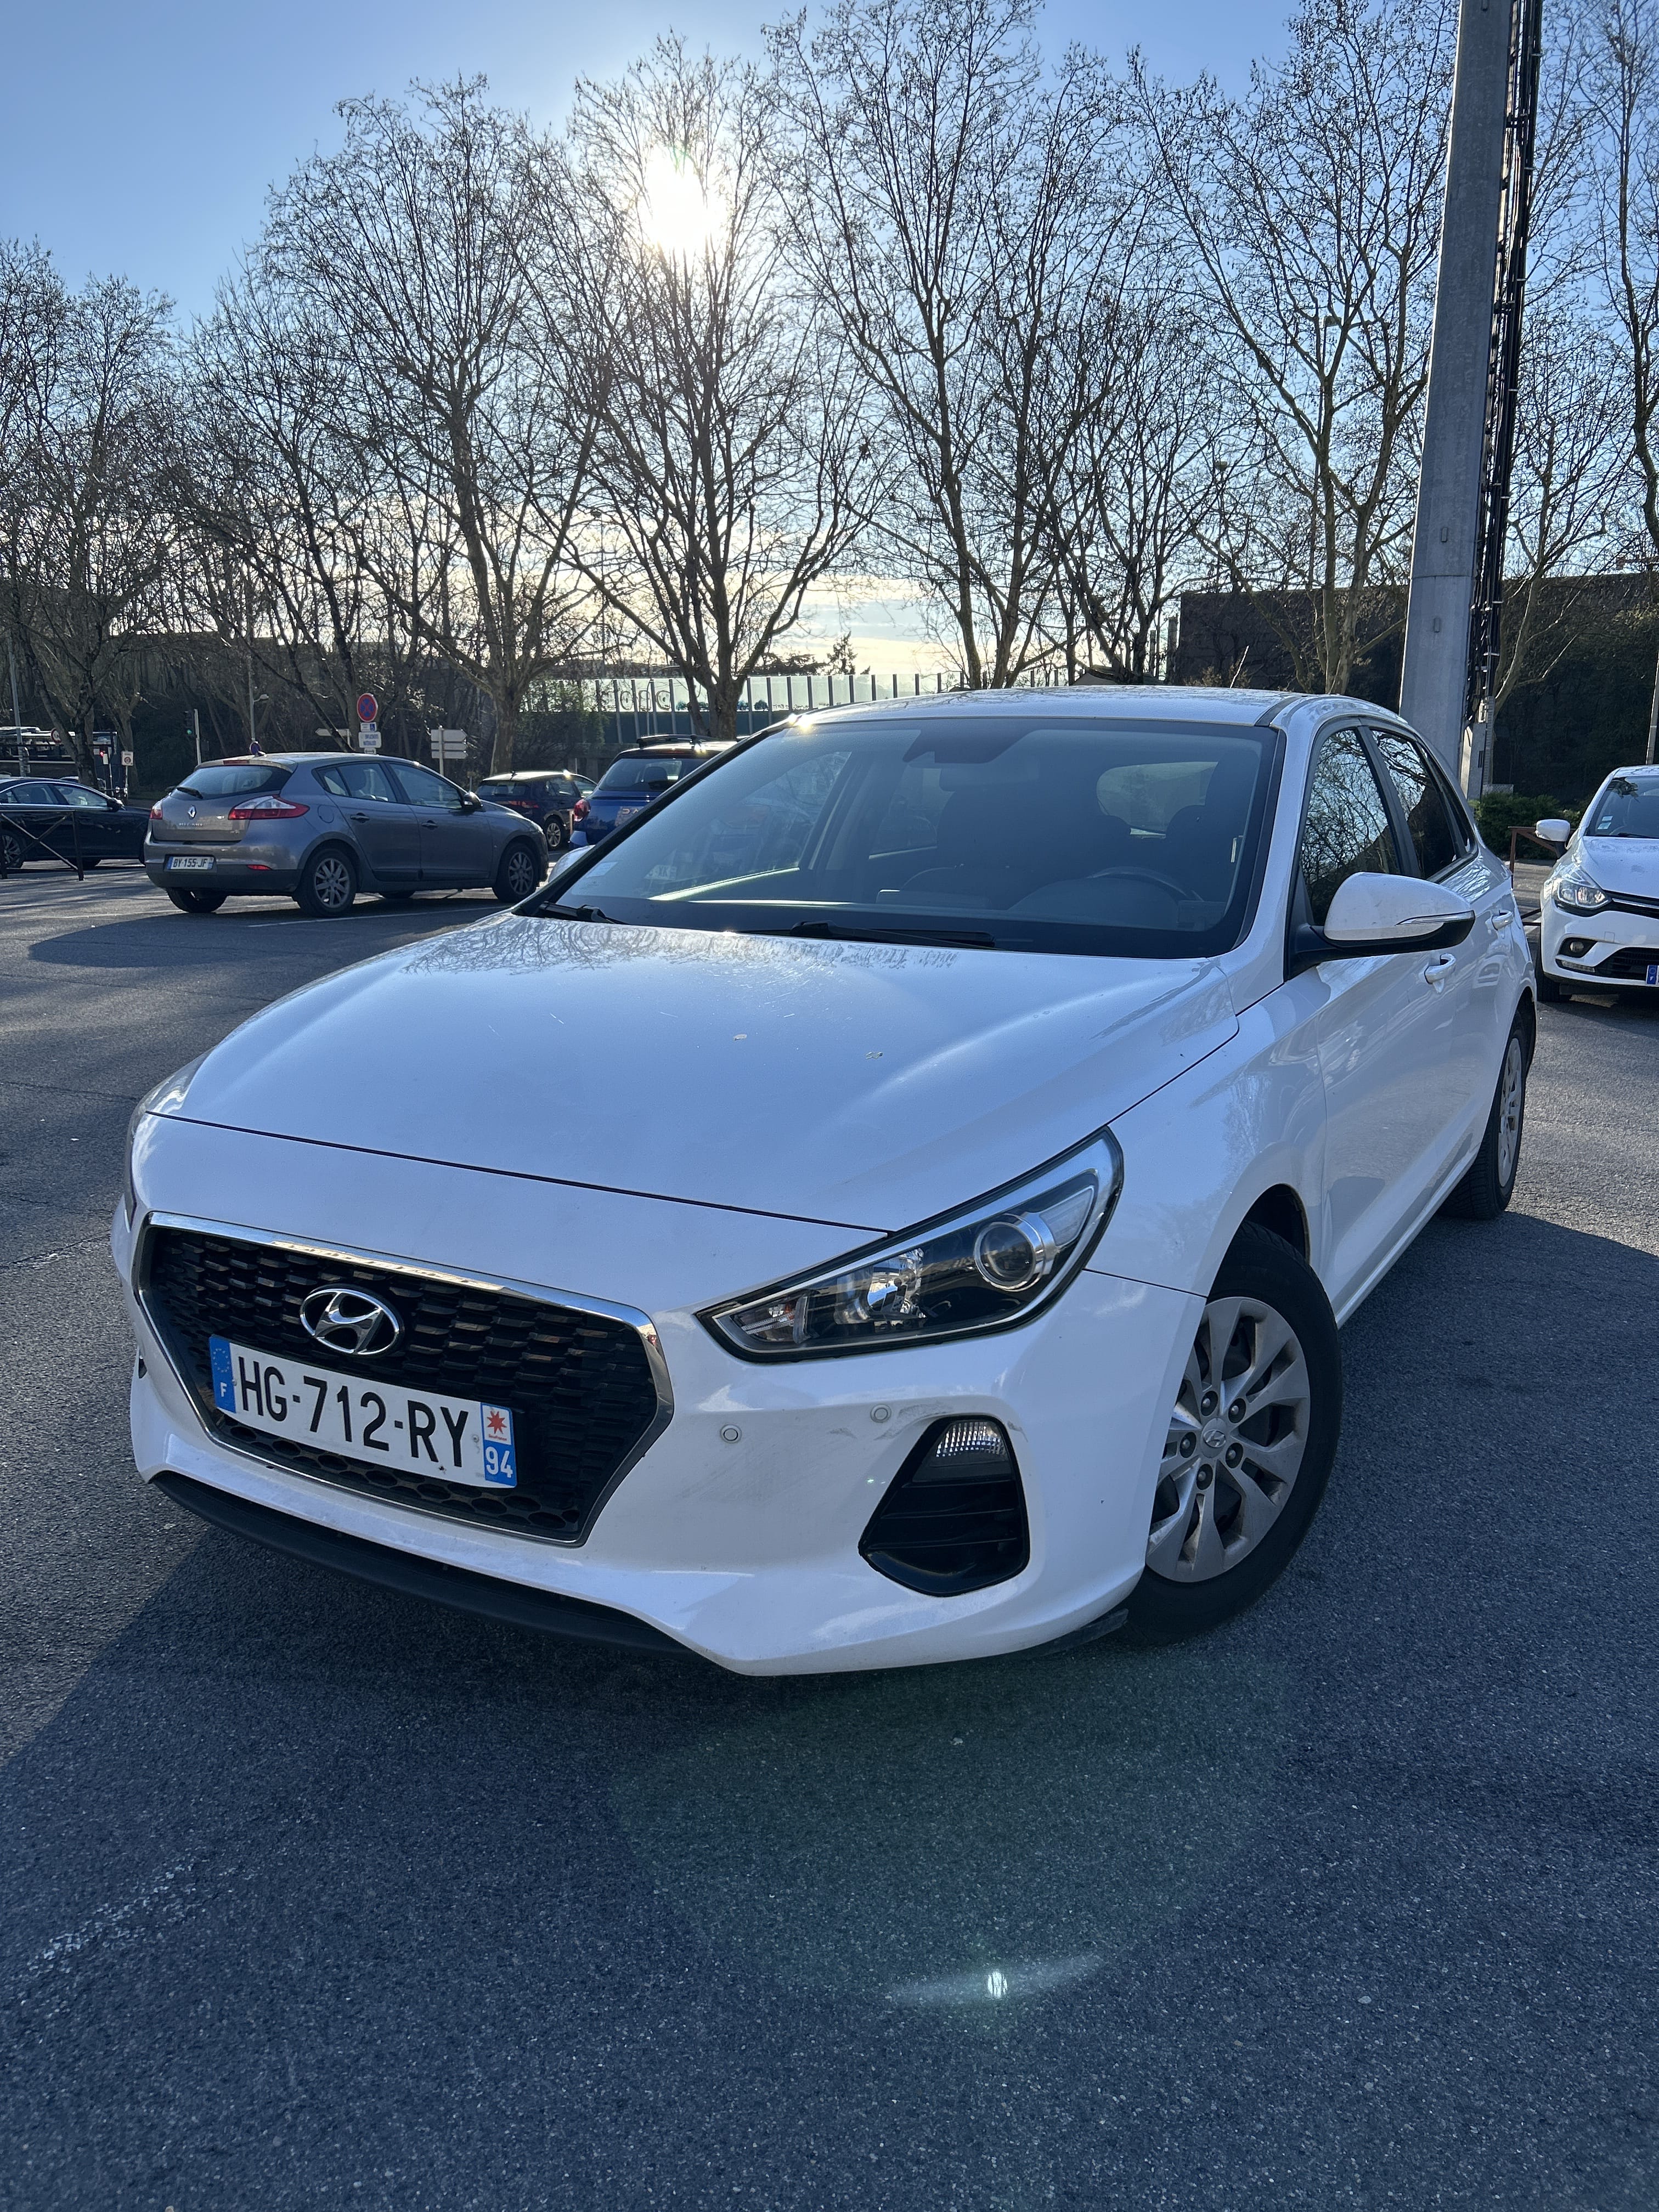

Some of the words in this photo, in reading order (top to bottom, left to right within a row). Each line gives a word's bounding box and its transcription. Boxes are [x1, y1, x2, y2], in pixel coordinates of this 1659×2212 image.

[220, 1382, 227, 1397] F
[239, 1356, 469, 1468] HG-712-RY
[486, 1446, 513, 1478] 94
